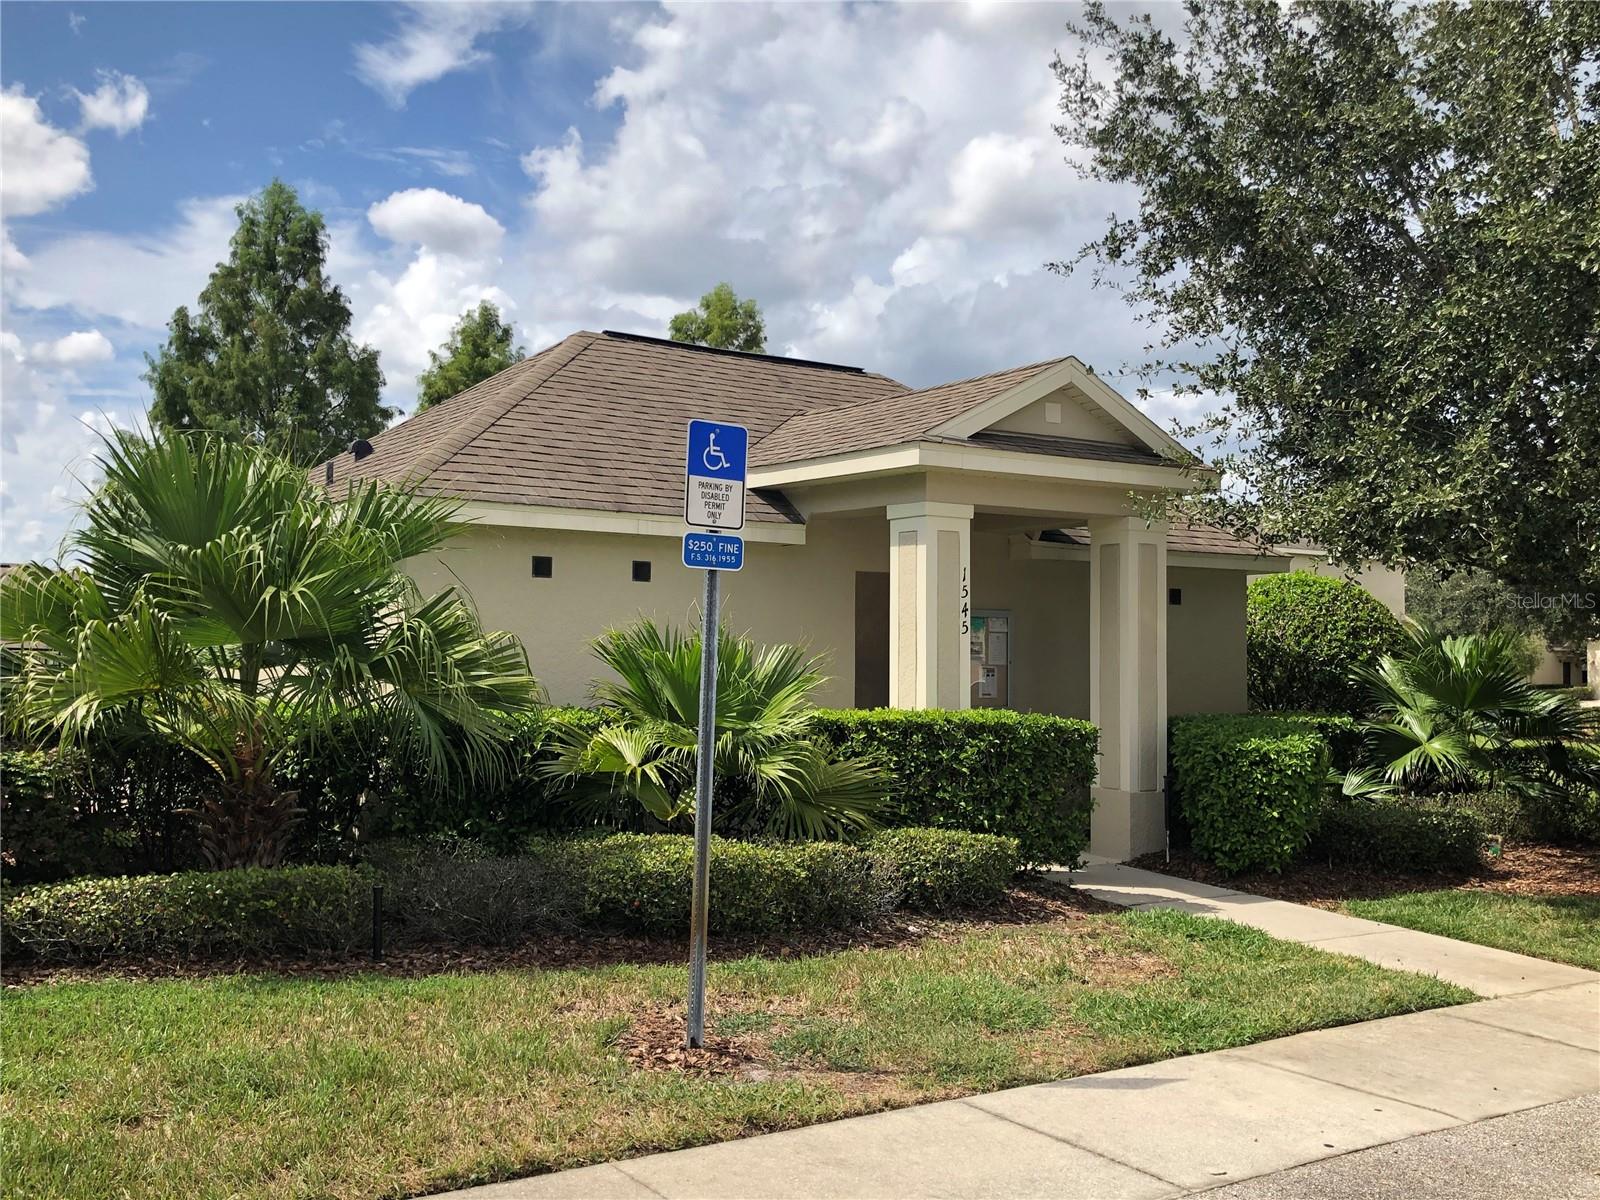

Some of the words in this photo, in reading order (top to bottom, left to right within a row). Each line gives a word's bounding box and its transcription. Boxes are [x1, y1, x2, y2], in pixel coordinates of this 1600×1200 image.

[698, 481, 722, 491] PARKING
[725, 484, 733, 492] BY
[701, 491, 729, 501] DISABLED
[704, 501, 725, 510] PERMIT
[707, 511, 721, 519] ONLY
[718, 543, 739, 554] FINE
